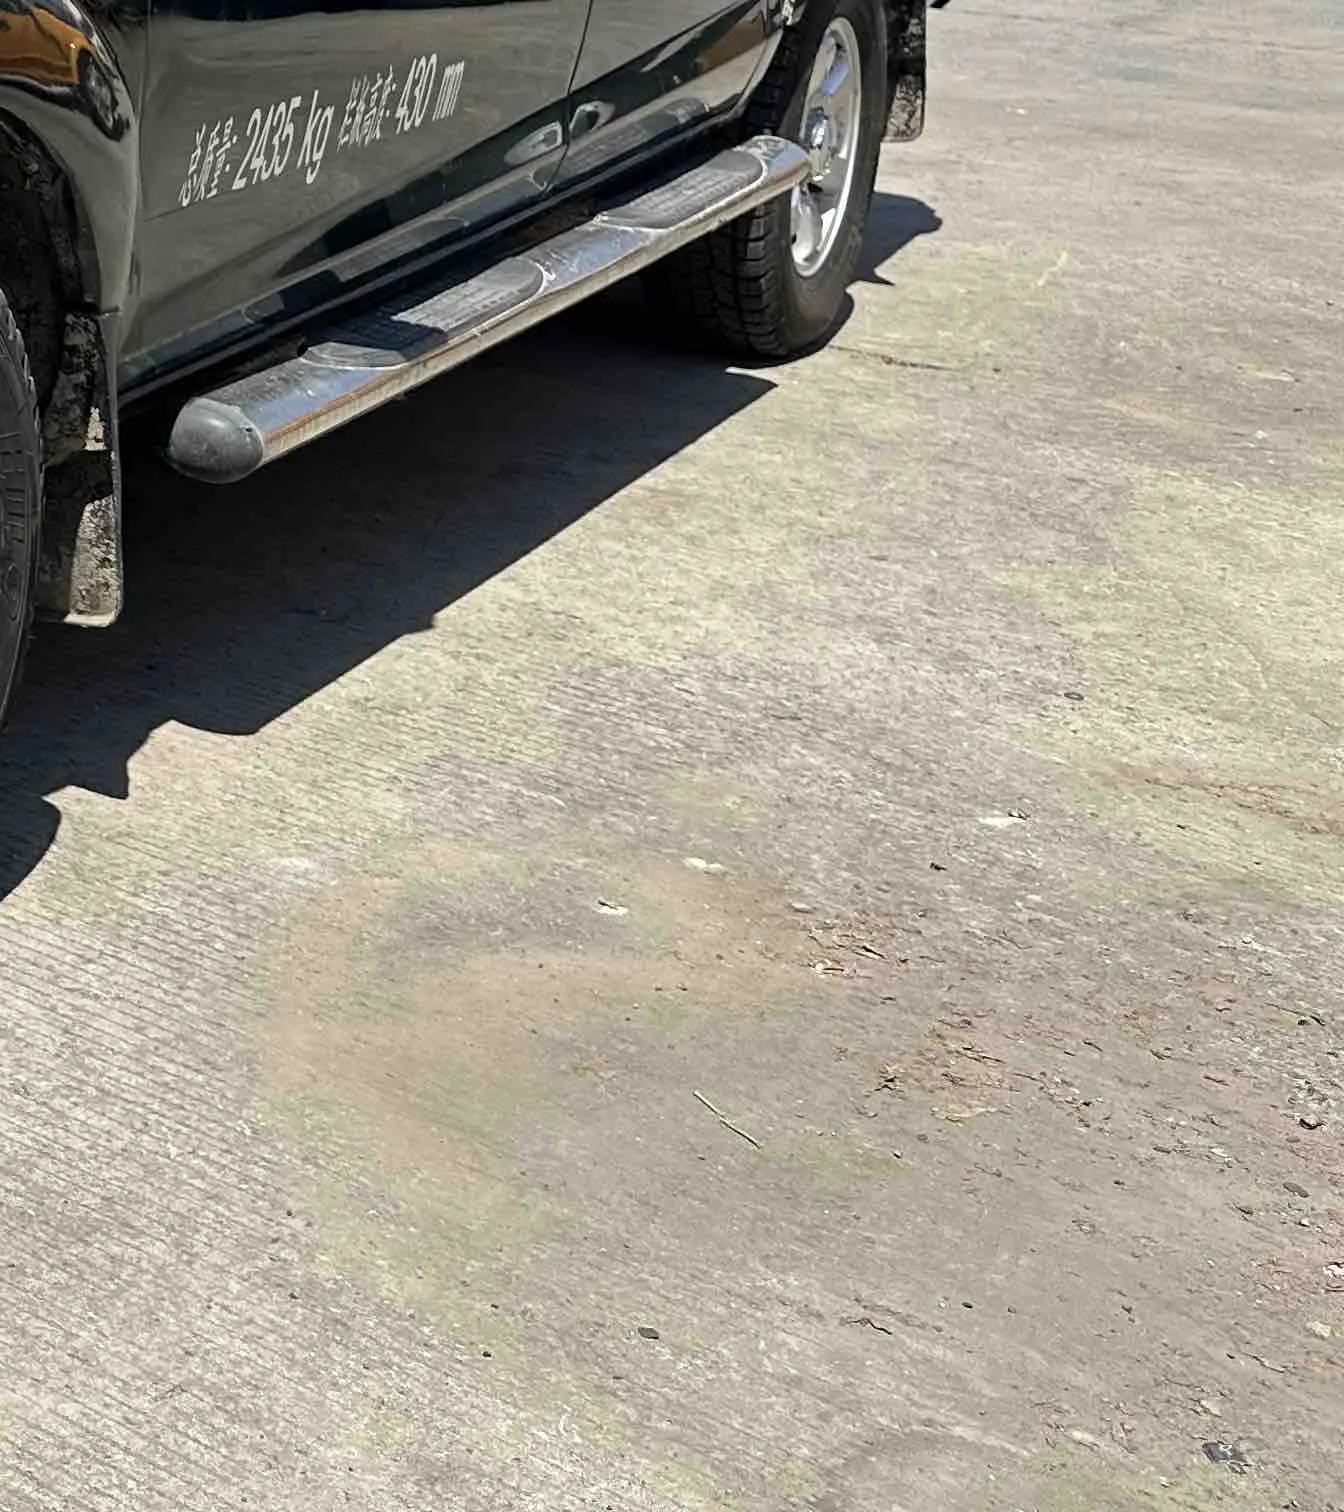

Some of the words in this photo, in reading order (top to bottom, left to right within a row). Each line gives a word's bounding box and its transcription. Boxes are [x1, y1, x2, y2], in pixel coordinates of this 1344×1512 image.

[232, 96, 301, 190] 2435
[297, 90, 334, 184] kg
[395, 53, 437, 134] 430
